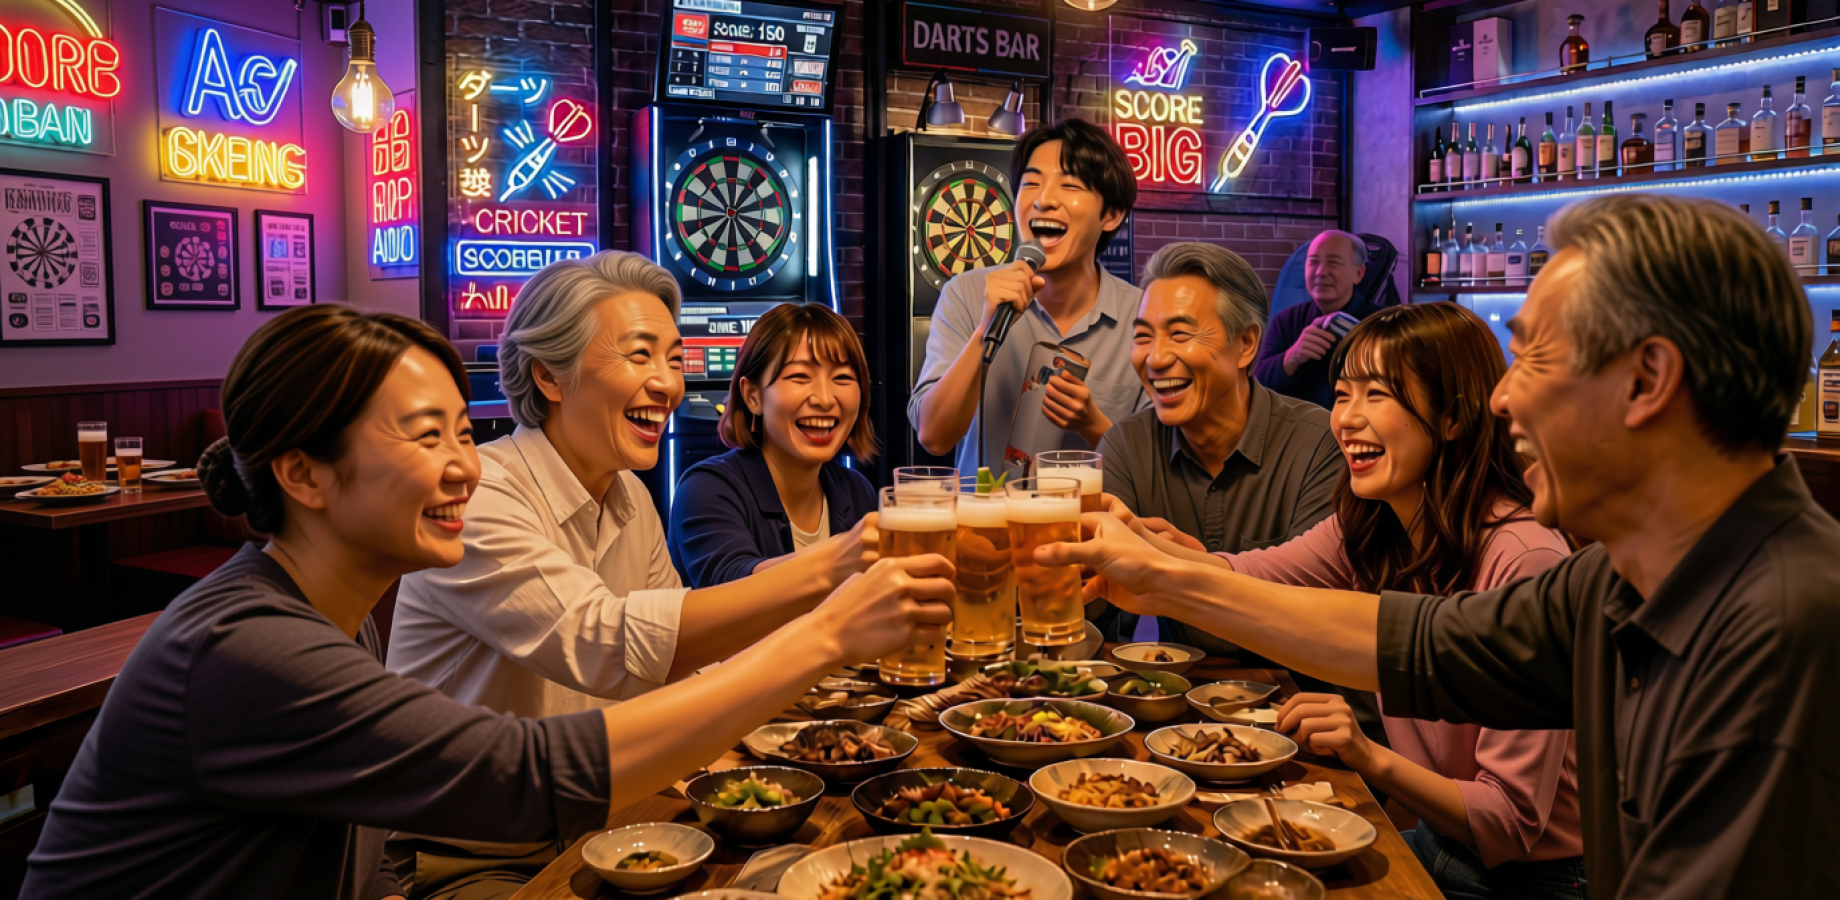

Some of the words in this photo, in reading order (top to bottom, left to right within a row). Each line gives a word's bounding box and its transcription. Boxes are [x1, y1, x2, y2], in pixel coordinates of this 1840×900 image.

[913, 20, 990, 55] DARTS
[995, 28, 1040, 61] BAR
[1114, 89, 1204, 124] SCORE
[1116, 122, 1202, 184] BIG
[475, 208, 589, 236] CRICKET
